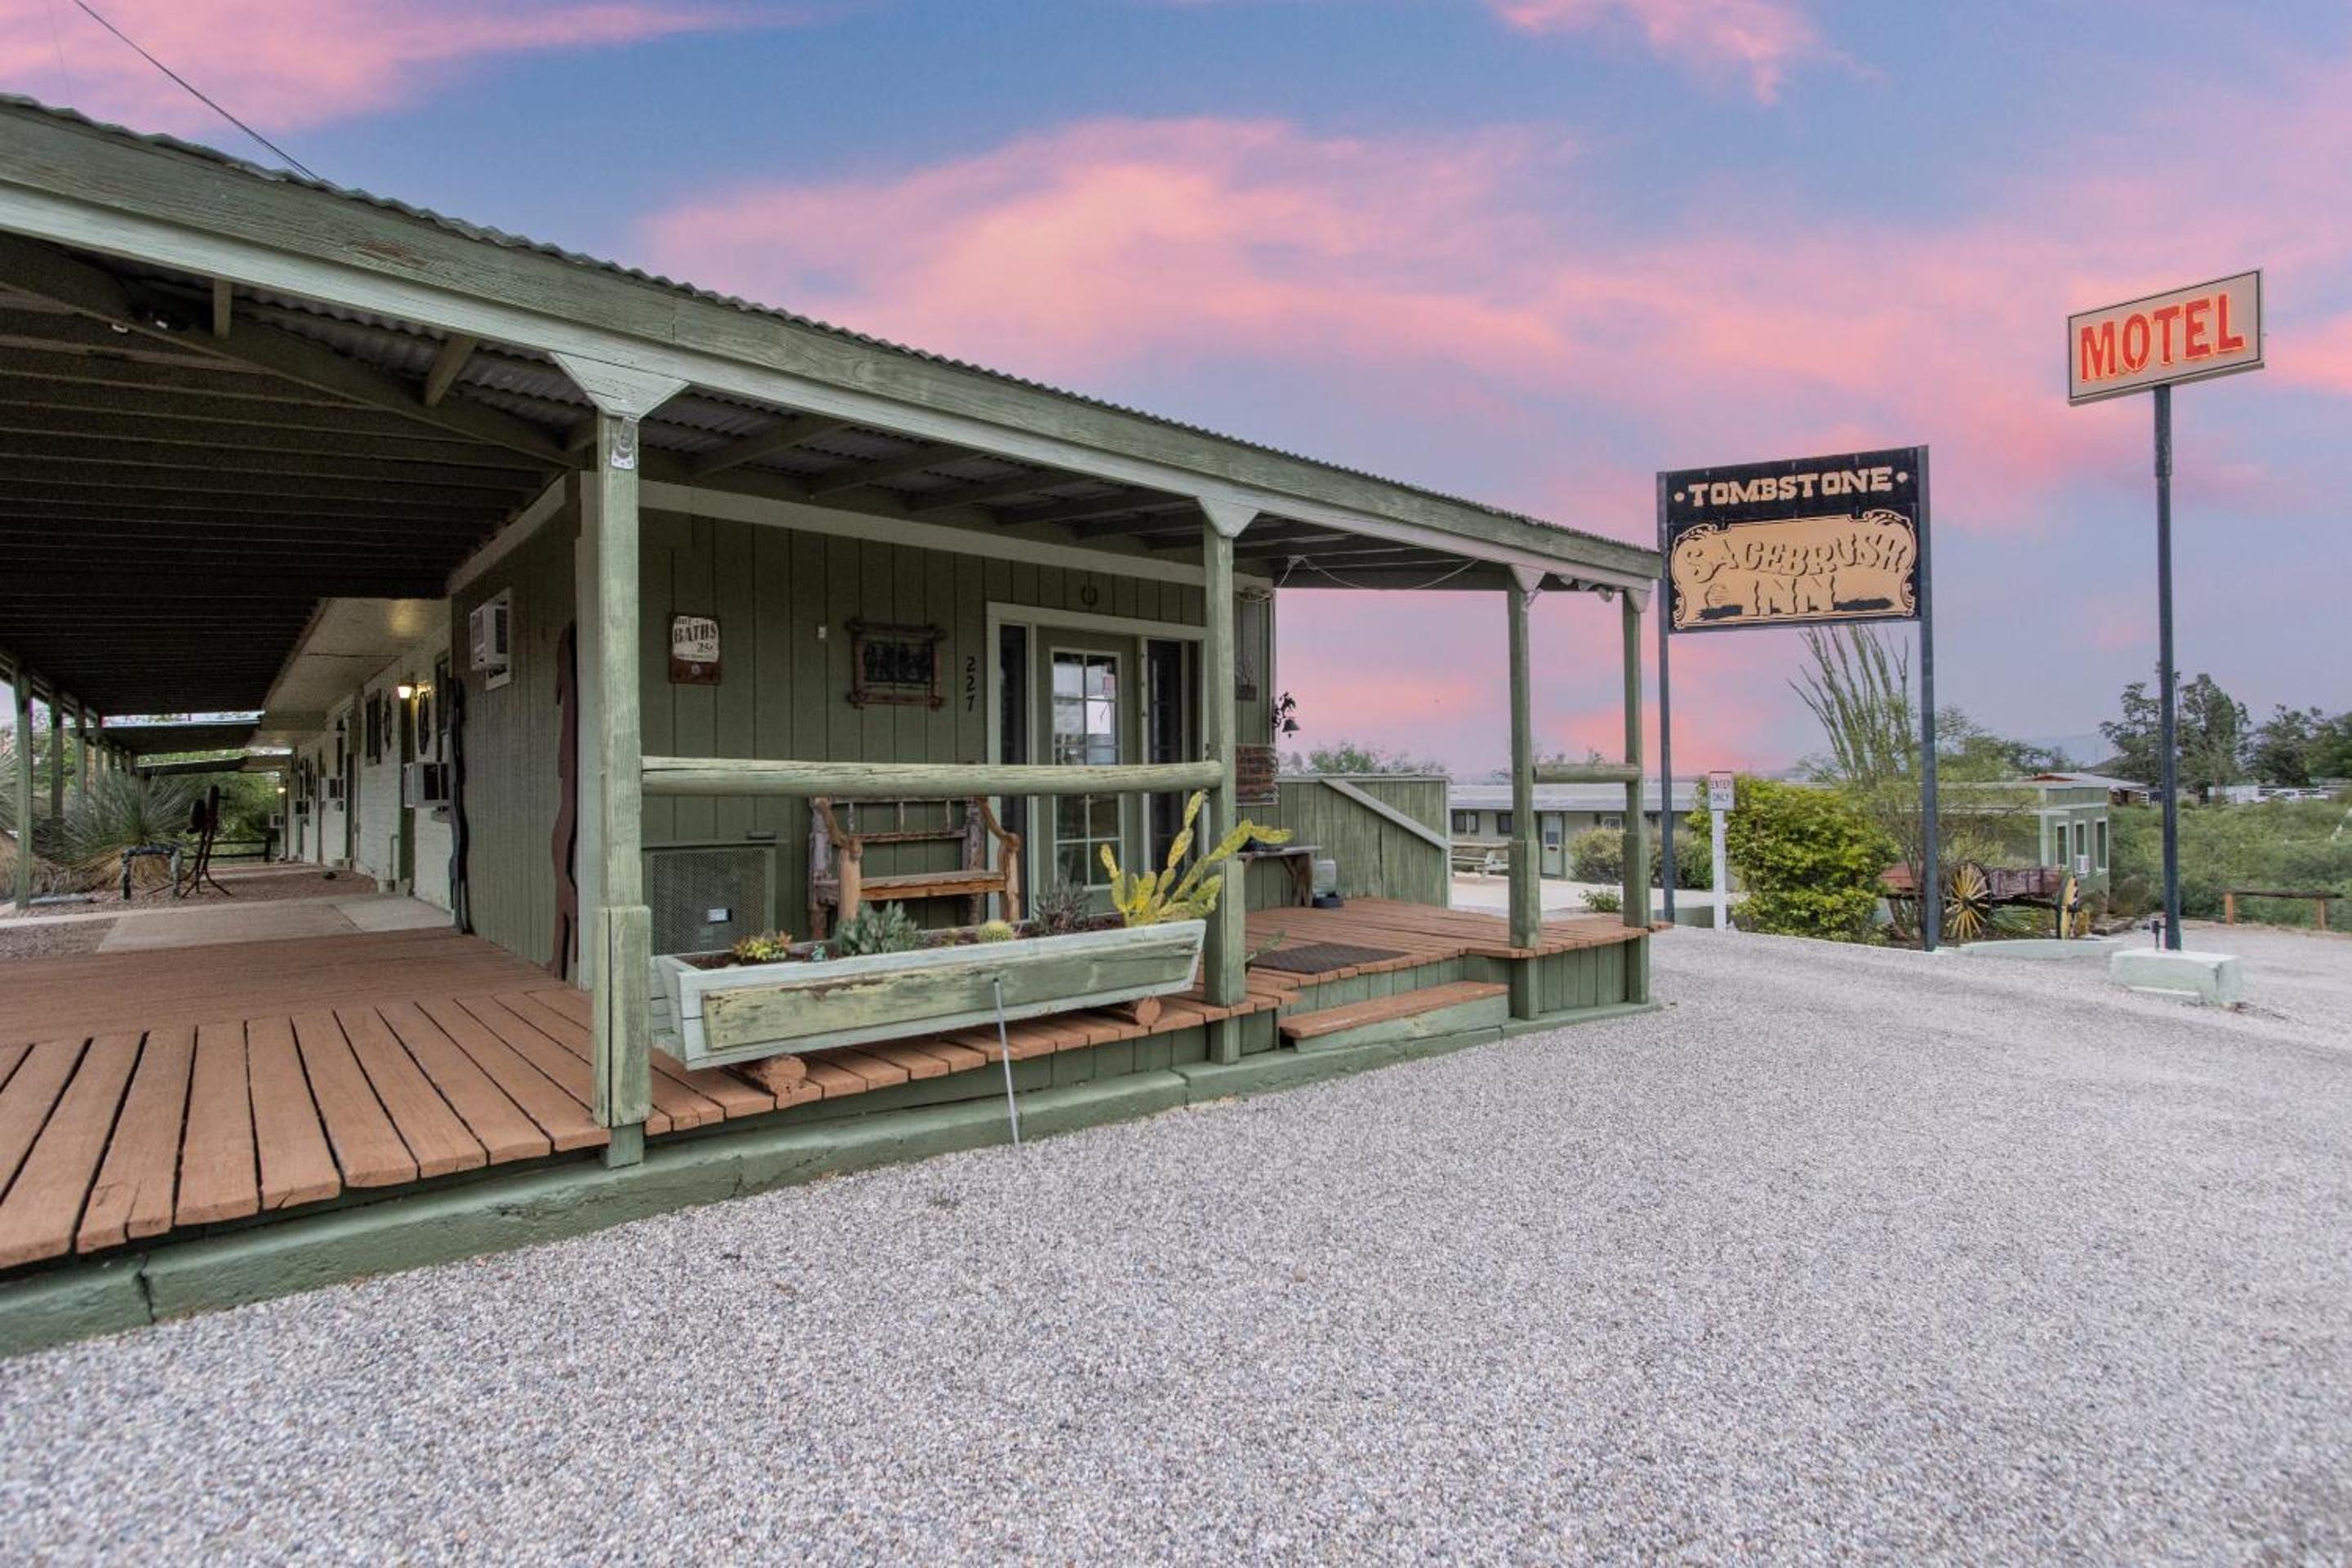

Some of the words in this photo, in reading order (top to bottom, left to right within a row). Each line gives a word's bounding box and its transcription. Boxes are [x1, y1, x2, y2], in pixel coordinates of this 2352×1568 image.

[2079, 292, 2246, 383] MOTEL
[1687, 466, 1894, 507] TOMBSTONE
[1682, 532, 1909, 583] SAGEBRUSH
[1741, 572, 1836, 616] INN
[674, 622, 717, 644] BATHS
[965, 655, 978, 713] 227
[1709, 779, 1731, 790] ENTER
